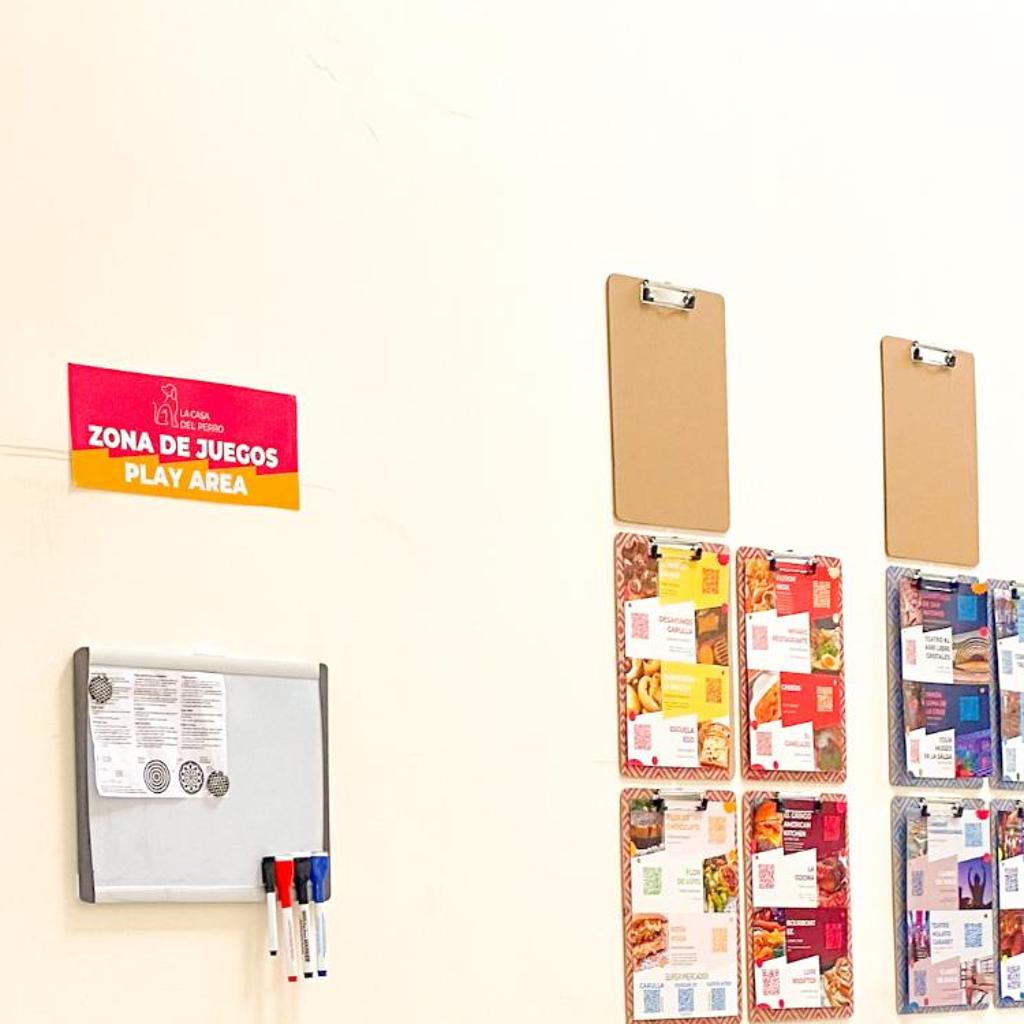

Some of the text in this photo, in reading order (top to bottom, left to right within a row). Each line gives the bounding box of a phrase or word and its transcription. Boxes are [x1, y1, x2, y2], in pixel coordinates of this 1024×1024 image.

[179, 408, 210, 420] LA CASA
[179, 420, 225, 434] DEL PERRO
[88, 425, 279, 468] ZONA DE JUEGOS
[124, 463, 248, 495] PLAY AREA
